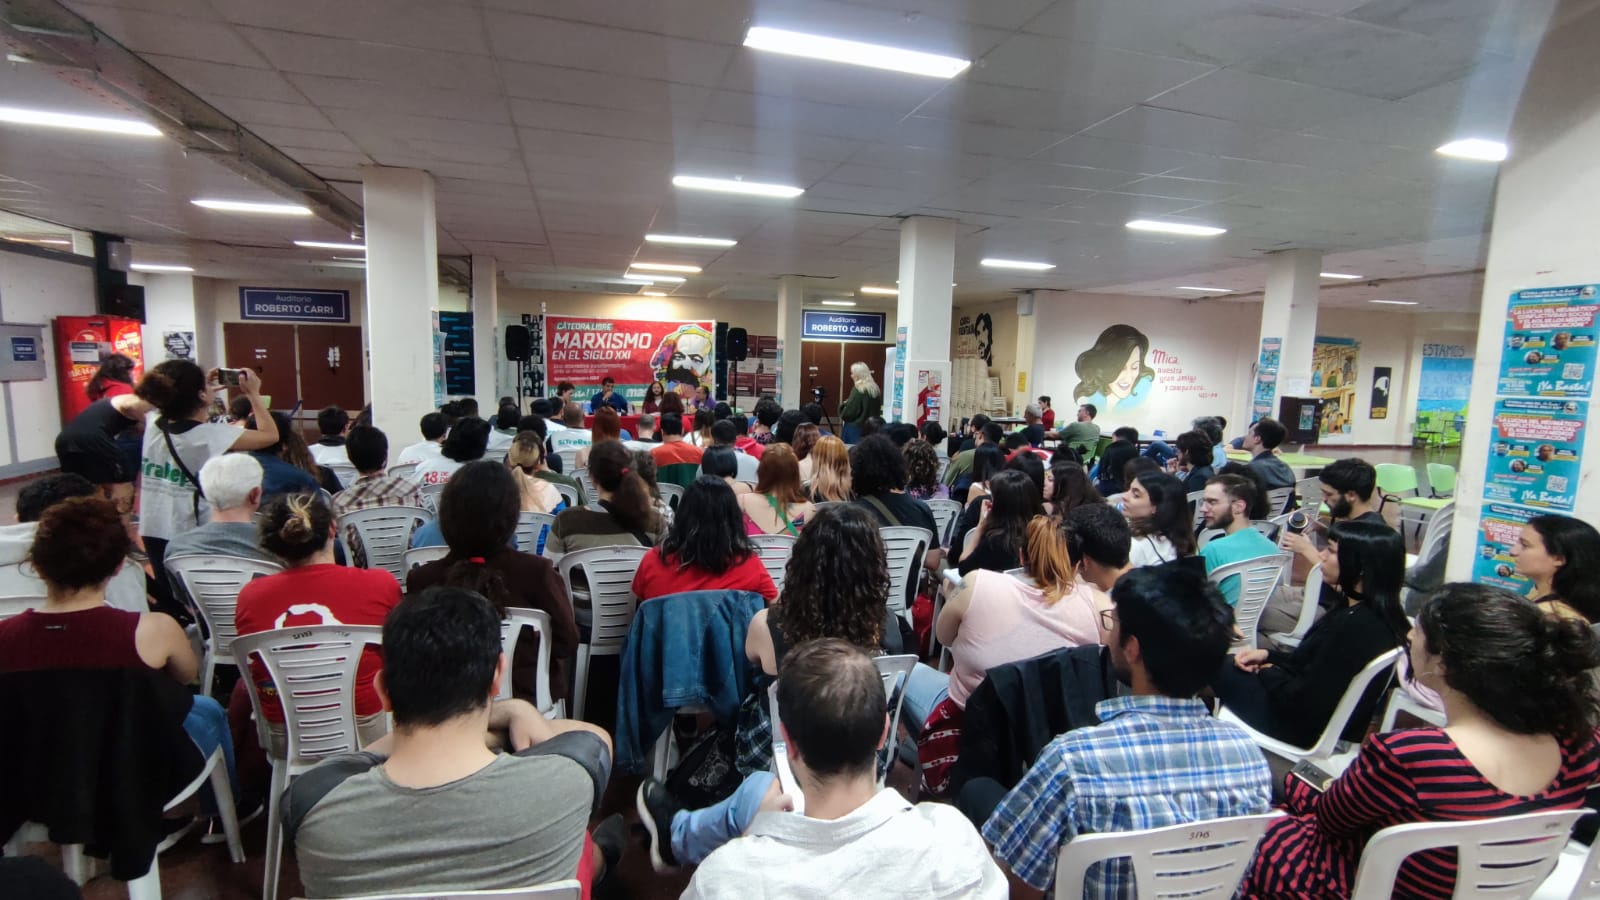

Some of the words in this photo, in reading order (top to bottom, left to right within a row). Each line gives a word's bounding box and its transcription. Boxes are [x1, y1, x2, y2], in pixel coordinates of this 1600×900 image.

[275, 294, 312, 303] Auditorio
[255, 304, 301, 313] ROBERTO
[304, 305, 334, 314] CARRI
[557, 322, 590, 330] CÁTEDRA
[812, 324, 848, 333] ROBERTO
[850, 325, 873, 334] CARRI
[553, 332, 652, 349] MARXISMO
[552, 350, 566, 360] EN
[568, 350, 581, 360] EL
[583, 350, 613, 360] SIGLO
[615, 350, 632, 360] XXI
[1152, 349, 1178, 364] Mica
[424, 471, 438, 484] 18
